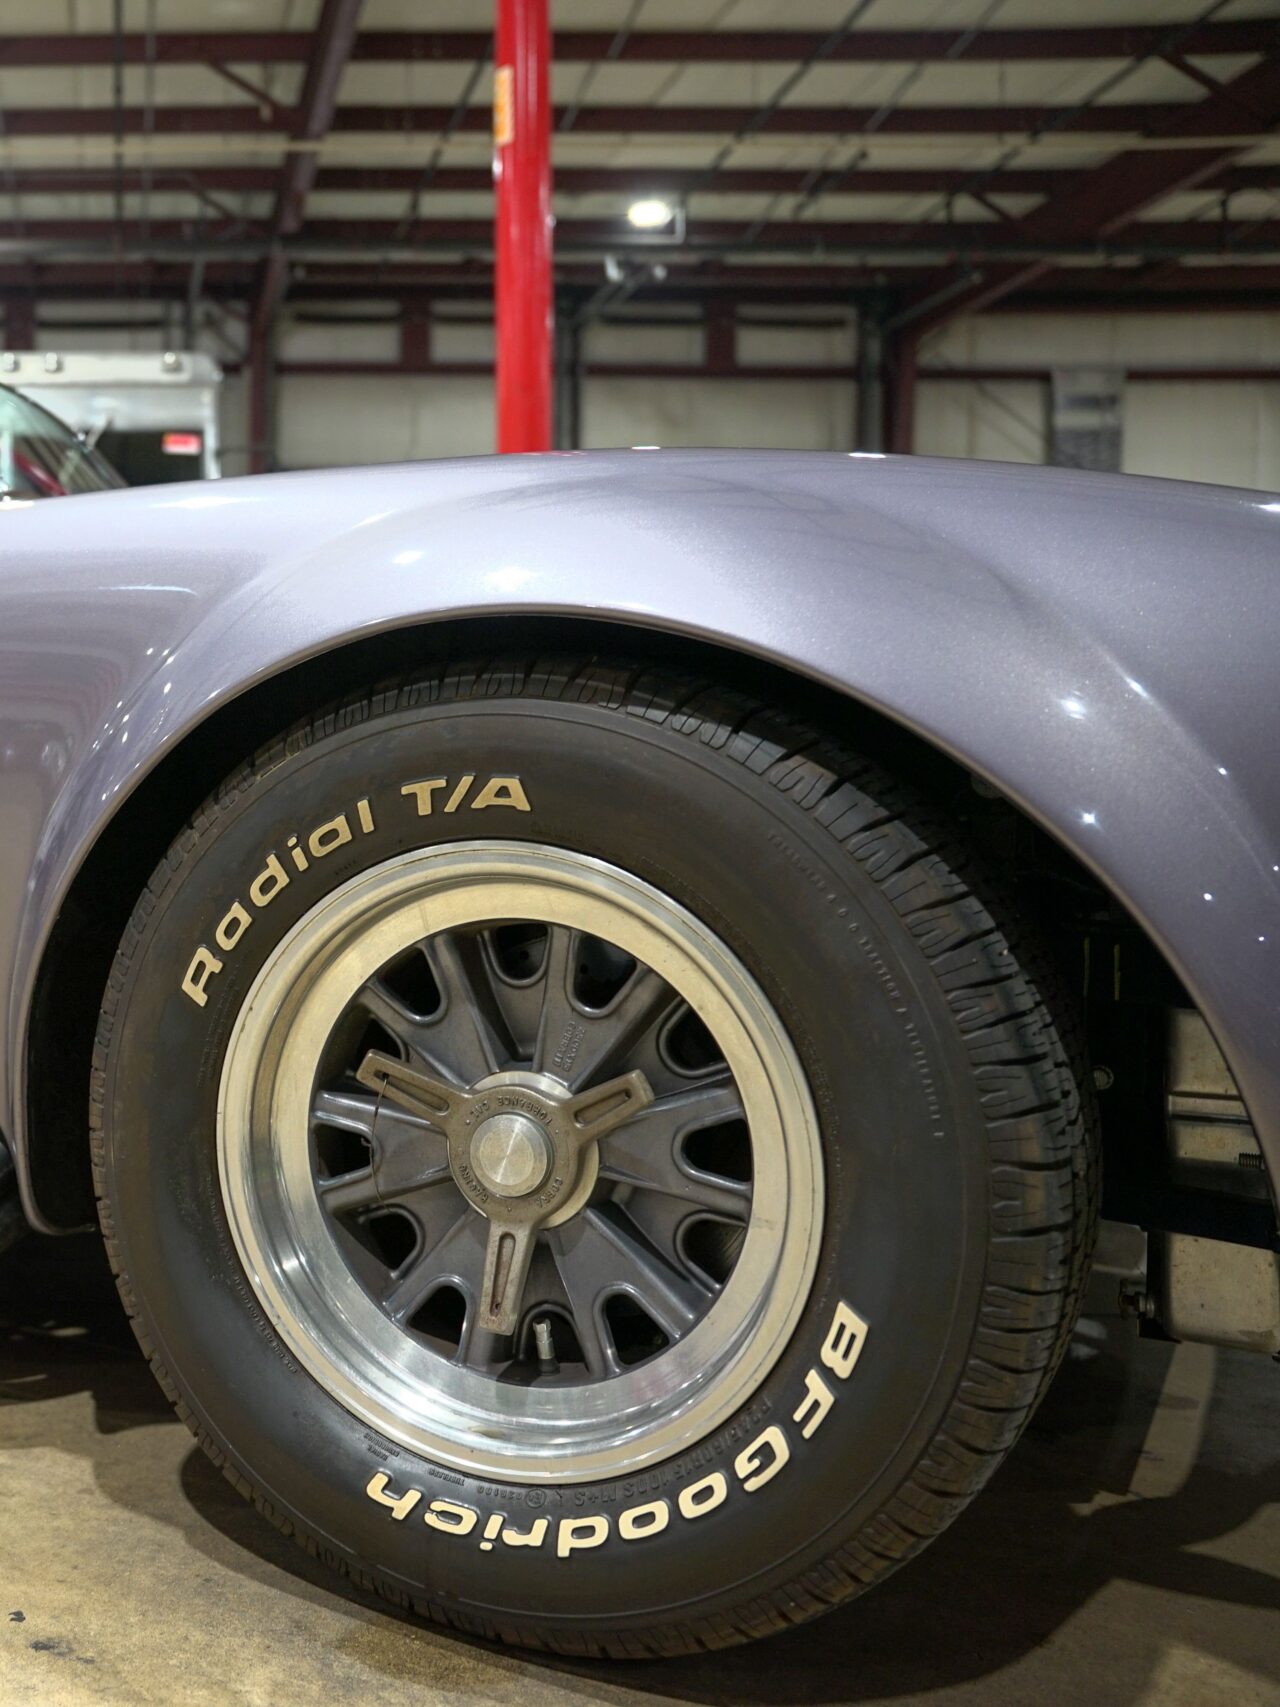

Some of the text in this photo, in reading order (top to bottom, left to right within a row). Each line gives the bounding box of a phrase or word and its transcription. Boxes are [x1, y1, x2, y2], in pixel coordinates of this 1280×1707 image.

[181, 774, 532, 1007] Radial T/A
[365, 1301, 869, 1558] BFGoodrich
